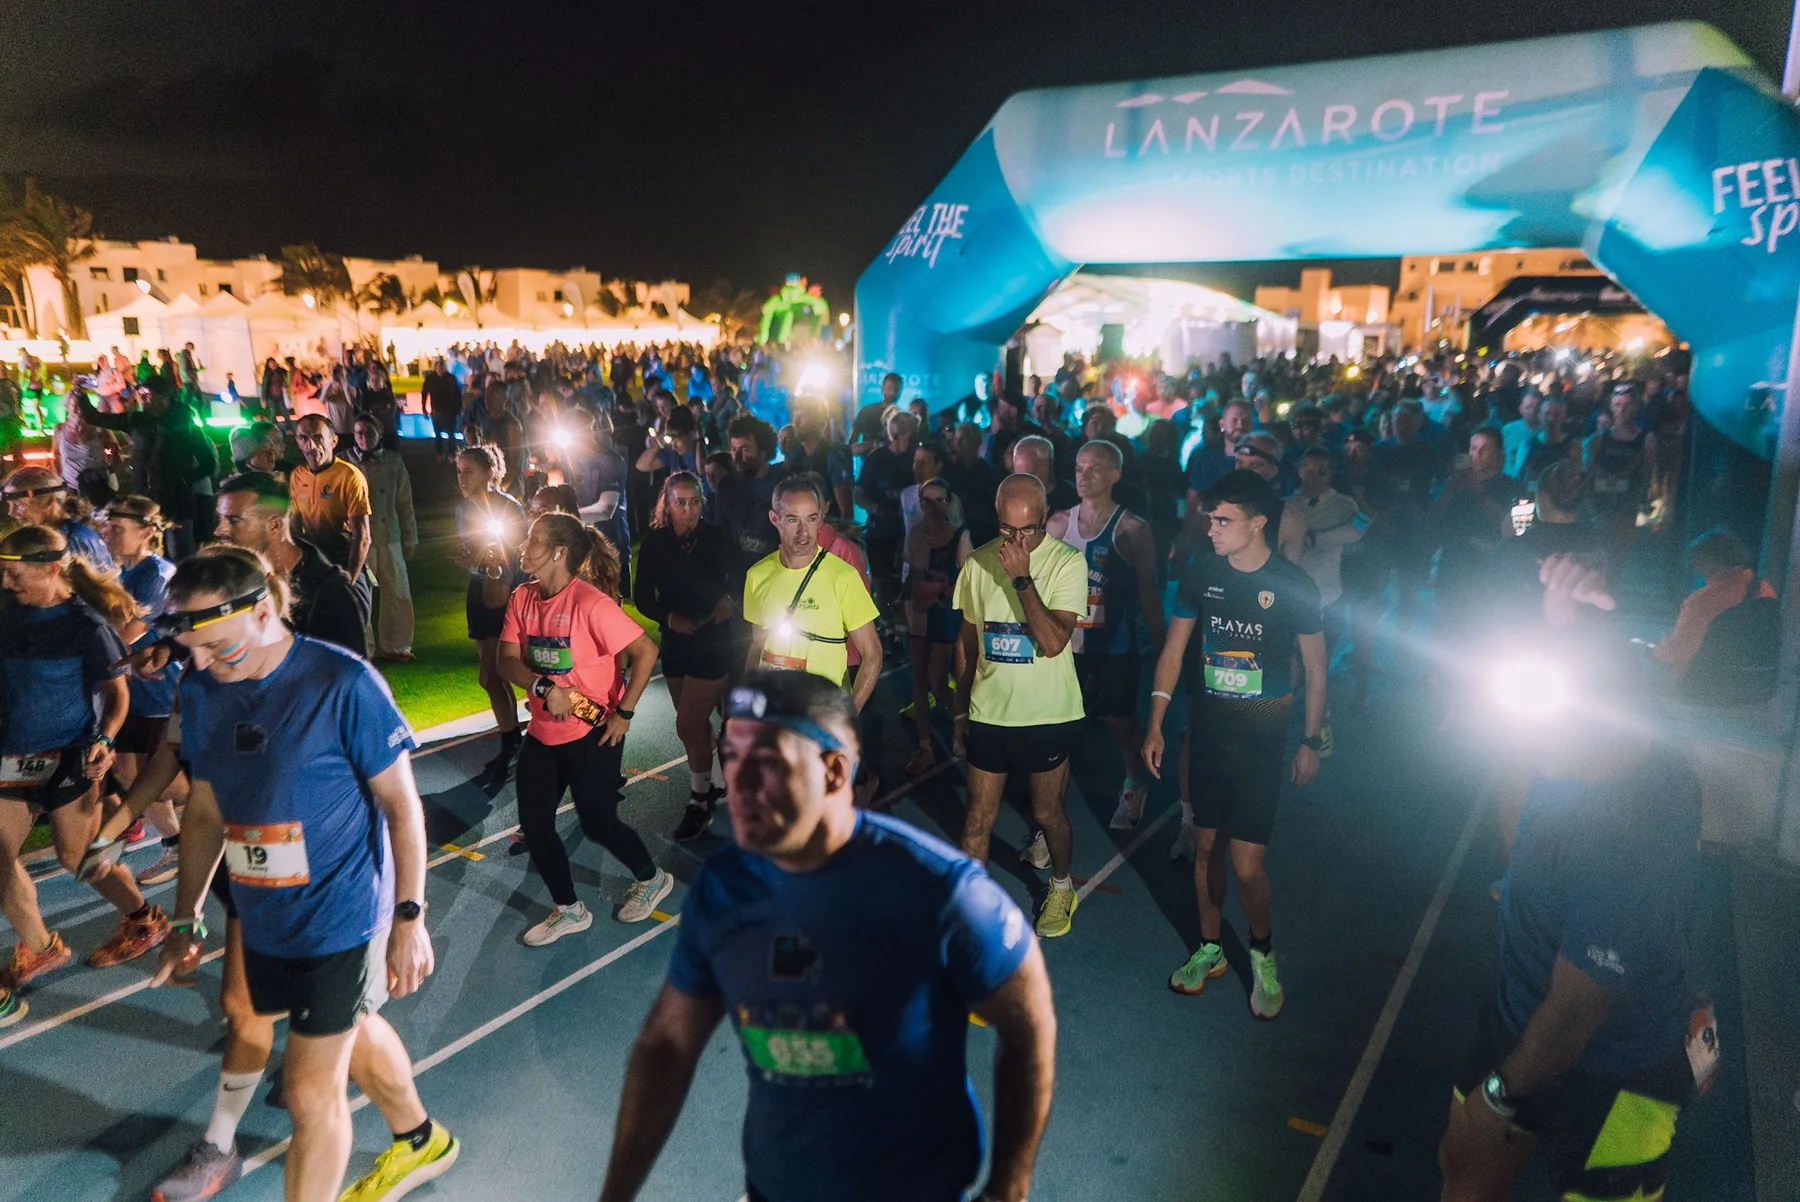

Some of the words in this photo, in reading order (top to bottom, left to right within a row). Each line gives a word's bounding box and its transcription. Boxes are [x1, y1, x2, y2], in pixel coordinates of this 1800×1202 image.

[1103, 89, 1510, 159] LANZAROTE
[1288, 153, 1501, 183] DESTINATION
[927, 202, 969, 238] THE
[1210, 615, 1263, 636] PLAYAS
[991, 637, 1021, 652] 607
[533, 649, 560, 664] 885
[1214, 669, 1247, 688] 709
[15, 759, 46, 772] 148
[243, 845, 268, 866] 19
